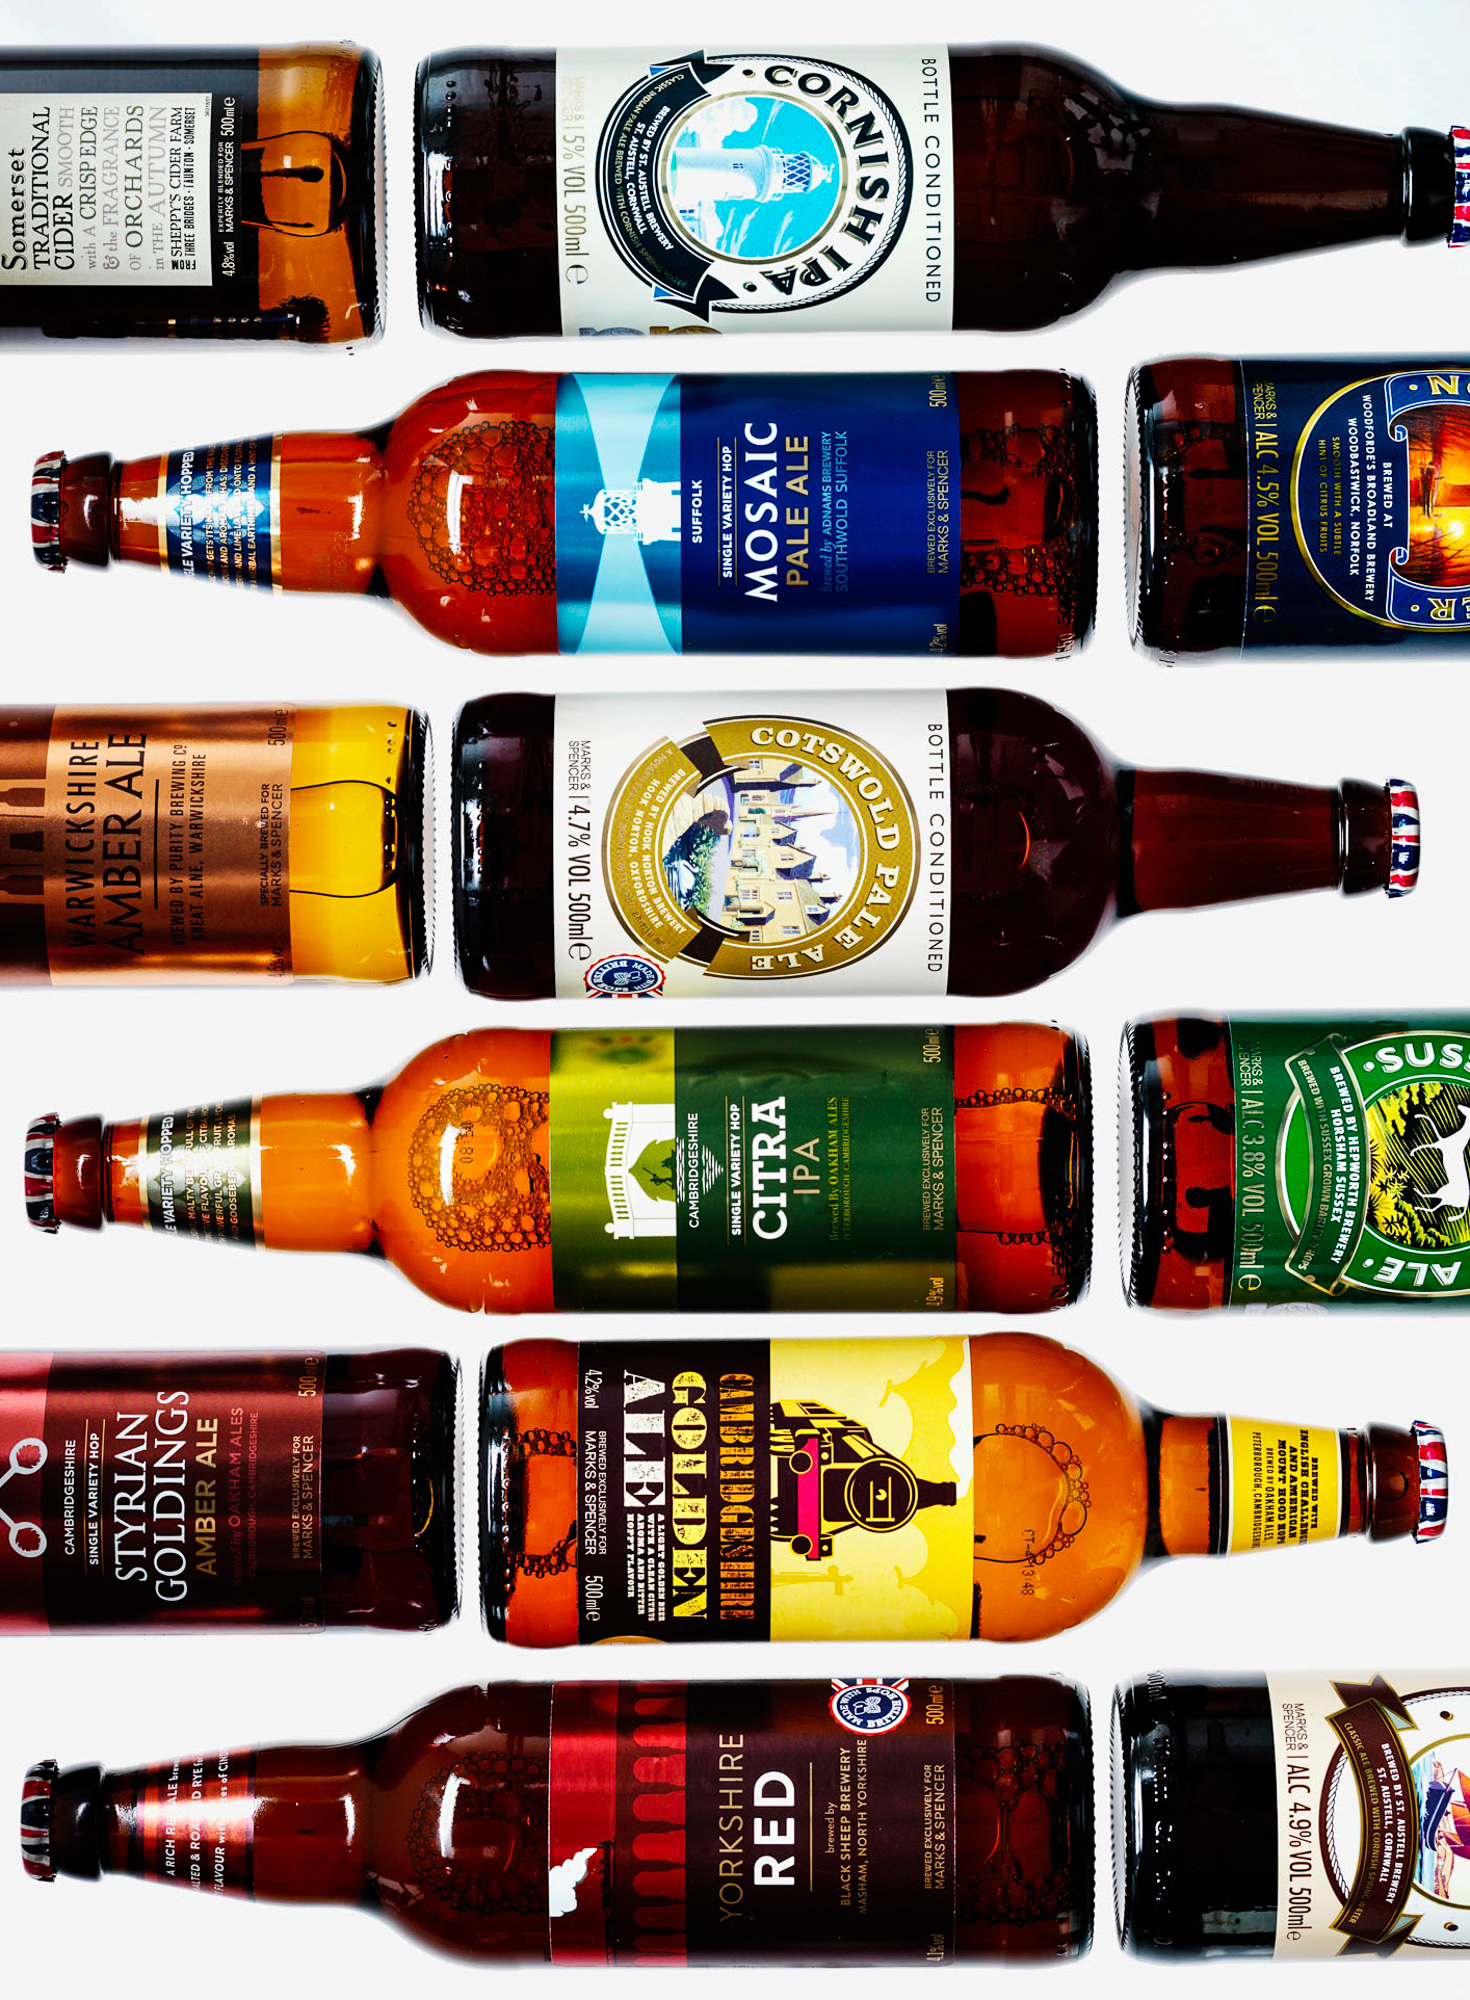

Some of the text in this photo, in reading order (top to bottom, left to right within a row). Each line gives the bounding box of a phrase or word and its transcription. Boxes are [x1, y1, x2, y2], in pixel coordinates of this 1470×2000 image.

[2, 146, 28, 271] Somerset
[31, 106, 50, 270] TRADITIONAL
[53, 107, 75, 270] CIDER SMOOTH
[79, 106, 98, 220] CRISP EDGE
[101, 106, 120, 226] FRAGRANCE
[124, 105, 144, 248] ORCHARDS
[148, 106, 167, 218] AUTUMN
[169, 107, 182, 257] SHEPPY'S CIDER FARM
[224, 142, 234, 186] SPENCER
[224, 196, 234, 232] MARKS
[563, 134, 589, 256] 5% VOL 500ml
[637, 105, 674, 251] BREWED BY ST. AUSTELL BREWERY
[759, 65, 889, 296] CORNISH IPA
[921, 58, 941, 302] BOTTLE CONDITIONED
[180, 451, 194, 558] VARIETY HOPPED
[692, 480, 702, 543] SUFFOLK
[722, 446, 733, 578] SINGLE VARIETY HOP
[744, 422, 778, 602] MOSAIC
[786, 436, 808, 585] PALE ALE
[822, 432, 832, 536] ADNAMS BREWERY
[938, 450, 948, 573] MARKS & SPENCER
[1255, 431, 1279, 600] ALC 4.5% VOL 500ml
[1348, 418, 1360, 576] WOODBASTWICK, NORFOLK
[1362, 395, 1376, 602] WOODFORDE'S BROADLAND BREWERY
[1383, 462, 1392, 528] BREWED AT
[170, 761, 186, 871] PURITY BREWING
[189, 754, 206, 898] ALNE, WARWICKSHIRE
[568, 740, 579, 791] SPENCER
[580, 740, 591, 790] MARKS &
[65, 742, 99, 948] WARWICKSHIRE
[102, 734, 146, 955] AMBER ALE
[271, 784, 283, 906] MARKS & SPENCER
[568, 804, 593, 940] 4.7% VOL 500ml
[642, 768, 686, 934] BREWED BY HOOK NORTON BREWERY
[751, 727, 900, 970] COTSWOLD PALE ALE
[928, 724, 944, 972] BOTTLE CONDITIONED
[688, 1113, 699, 1228] CAMBRIDGESHIRE
[730, 1104, 741, 1236] SINGLE VARIETY HOP
[752, 1096, 788, 1240] CITRA
[792, 1138, 820, 1194] IPA
[827, 1097, 838, 1185] OAKHAM ALES
[932, 1107, 944, 1230] MARKS & SPENCER
[1240, 1098, 1265, 1268] ALC 3.8% VOL 500ml
[1330, 1066, 1360, 1264] BREWED BY HEPWORTH BREWERY
[1330, 1109, 1346, 1223] HORSHAM SUSSEX
[1374, 1256, 1462, 1286] ALE
[64, 1440, 76, 1555] CAMBRIDGESHIRE
[88, 1432, 100, 1565] SINGLE VARIETY HOP
[113, 1412, 149, 1582] STYRIAN
[153, 1391, 190, 1602] GOLDINGS
[194, 1418, 218, 1576] AMBER ALE
[624, 1370, 666, 1508] ALE
[672, 1371, 707, 1620] GOLDEN
[720, 1374, 756, 1620] CAMBRIDGESHIRE
[1277, 1440, 1286, 1544] MOUNT HOOD HOPS
[1289, 1446, 1298, 1538] AND AMERICAN
[637, 1514, 645, 1615] AROMA AND BITTER
[718, 1734, 744, 1922] YORKSHIRE
[753, 1771, 796, 1886] RED
[825, 1802, 838, 1854] brewed by
[840, 1748, 851, 1906] BLACK SHEEP BREWERY
[857, 1740, 868, 1856] NORTH YORKSHIRE
[934, 1764, 946, 1889] MARKS & SPENCER
[1288, 1764, 1310, 1794] ALC
[1289, 1802, 1312, 1848] 4.9%
[1377, 1768, 1393, 1882] ST. AUSTELL, CORNWALL
[1382, 1743, 1406, 1904] BREWED BY ST. AUSTELL BREWERY
[1289, 1850, 1312, 1882] VOL
